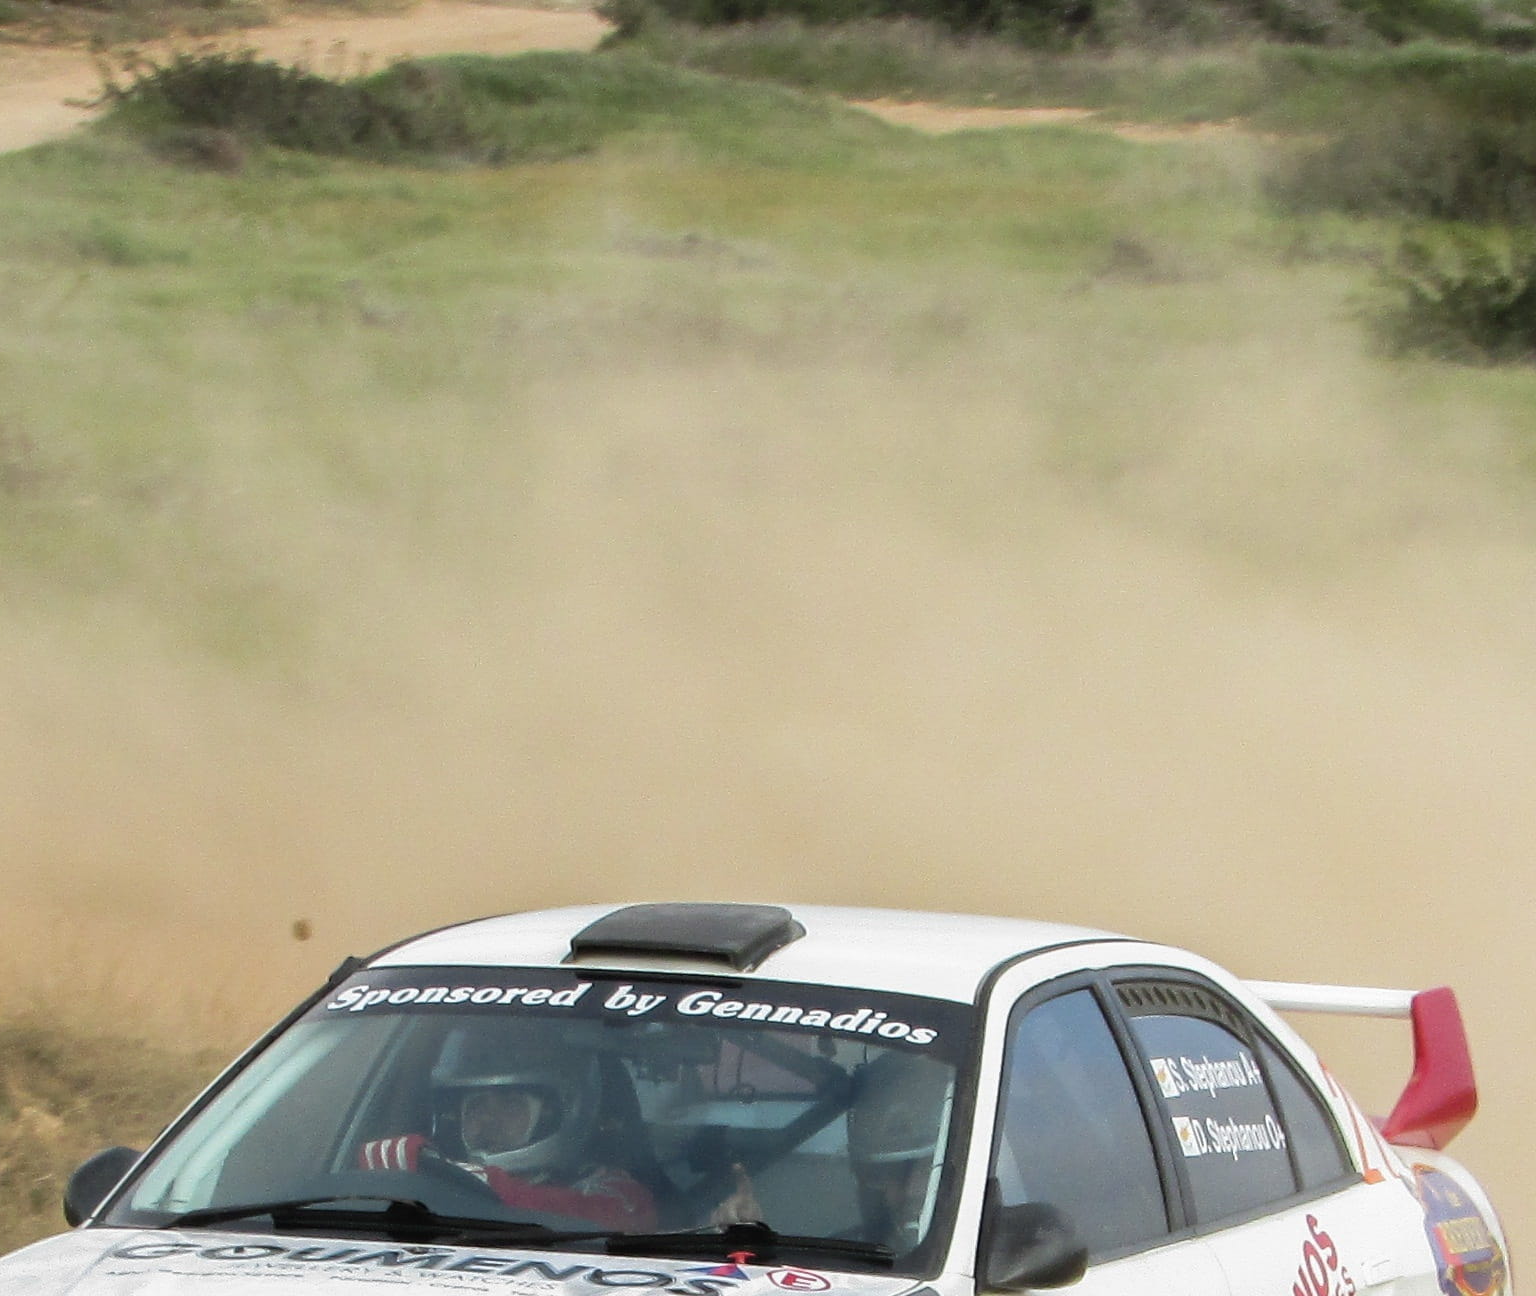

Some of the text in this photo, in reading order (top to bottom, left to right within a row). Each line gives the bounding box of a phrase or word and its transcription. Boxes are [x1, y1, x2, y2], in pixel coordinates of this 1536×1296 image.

[327, 982, 939, 1045] Sponsored by Gennadios
[1180, 1056, 1248, 1098] Stephanou
[1192, 1118, 1213, 1154] D.
[1206, 1116, 1272, 1161] Stephanou
